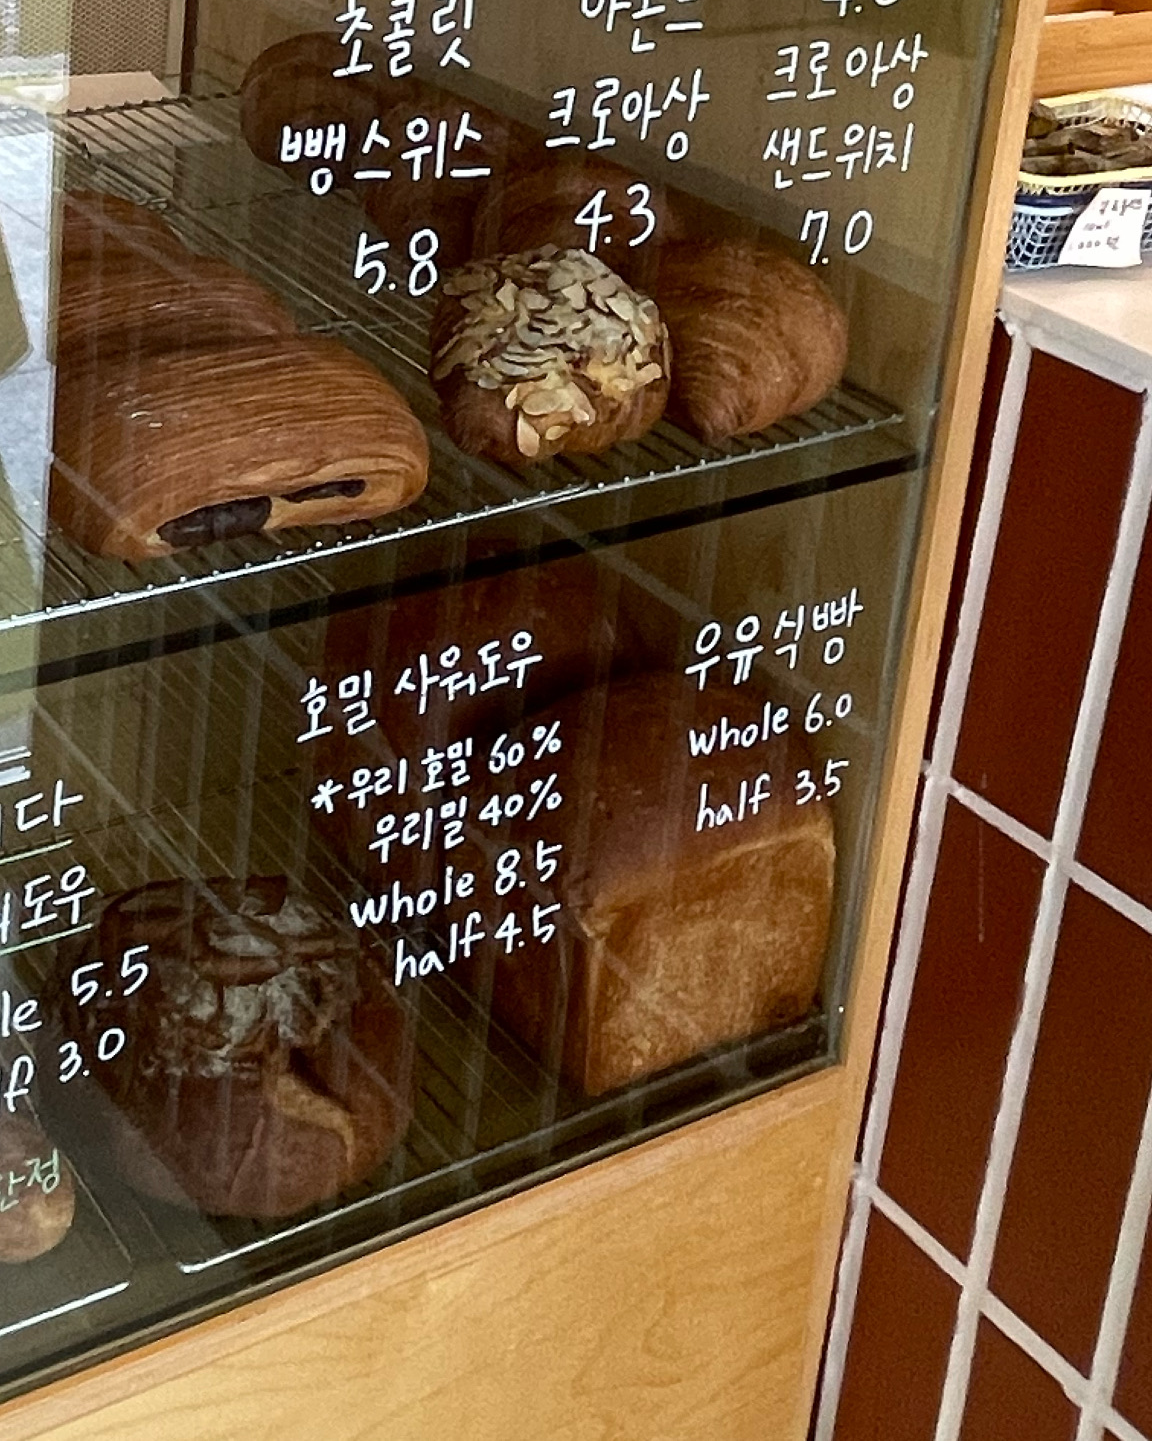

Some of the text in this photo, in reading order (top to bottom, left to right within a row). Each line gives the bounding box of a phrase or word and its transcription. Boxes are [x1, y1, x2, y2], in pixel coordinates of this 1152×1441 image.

[766, 33, 929, 110] 크로아상
[546, 68, 710, 161] 크로아상
[763, 122, 916, 191] 샌드위치
[573, 182, 656, 252] 4.3
[799, 209, 873, 266] 7.0
[353, 229, 440, 296] 5.8
[296, 630, 543, 743] 호밀 사워도우
[421, 738, 473, 790] 호밀
[487, 722, 563, 772] 60%
[689, 693, 853, 757] whole 6.0
[369, 775, 563, 864] 우리밀 40%
[696, 760, 849, 832] half 3.5
[349, 841, 563, 929] whole 8.5
[71, 945, 149, 1008] 5.5
[393, 903, 563, 987] half 4.5
[57, 1027, 125, 1083] 3.0
